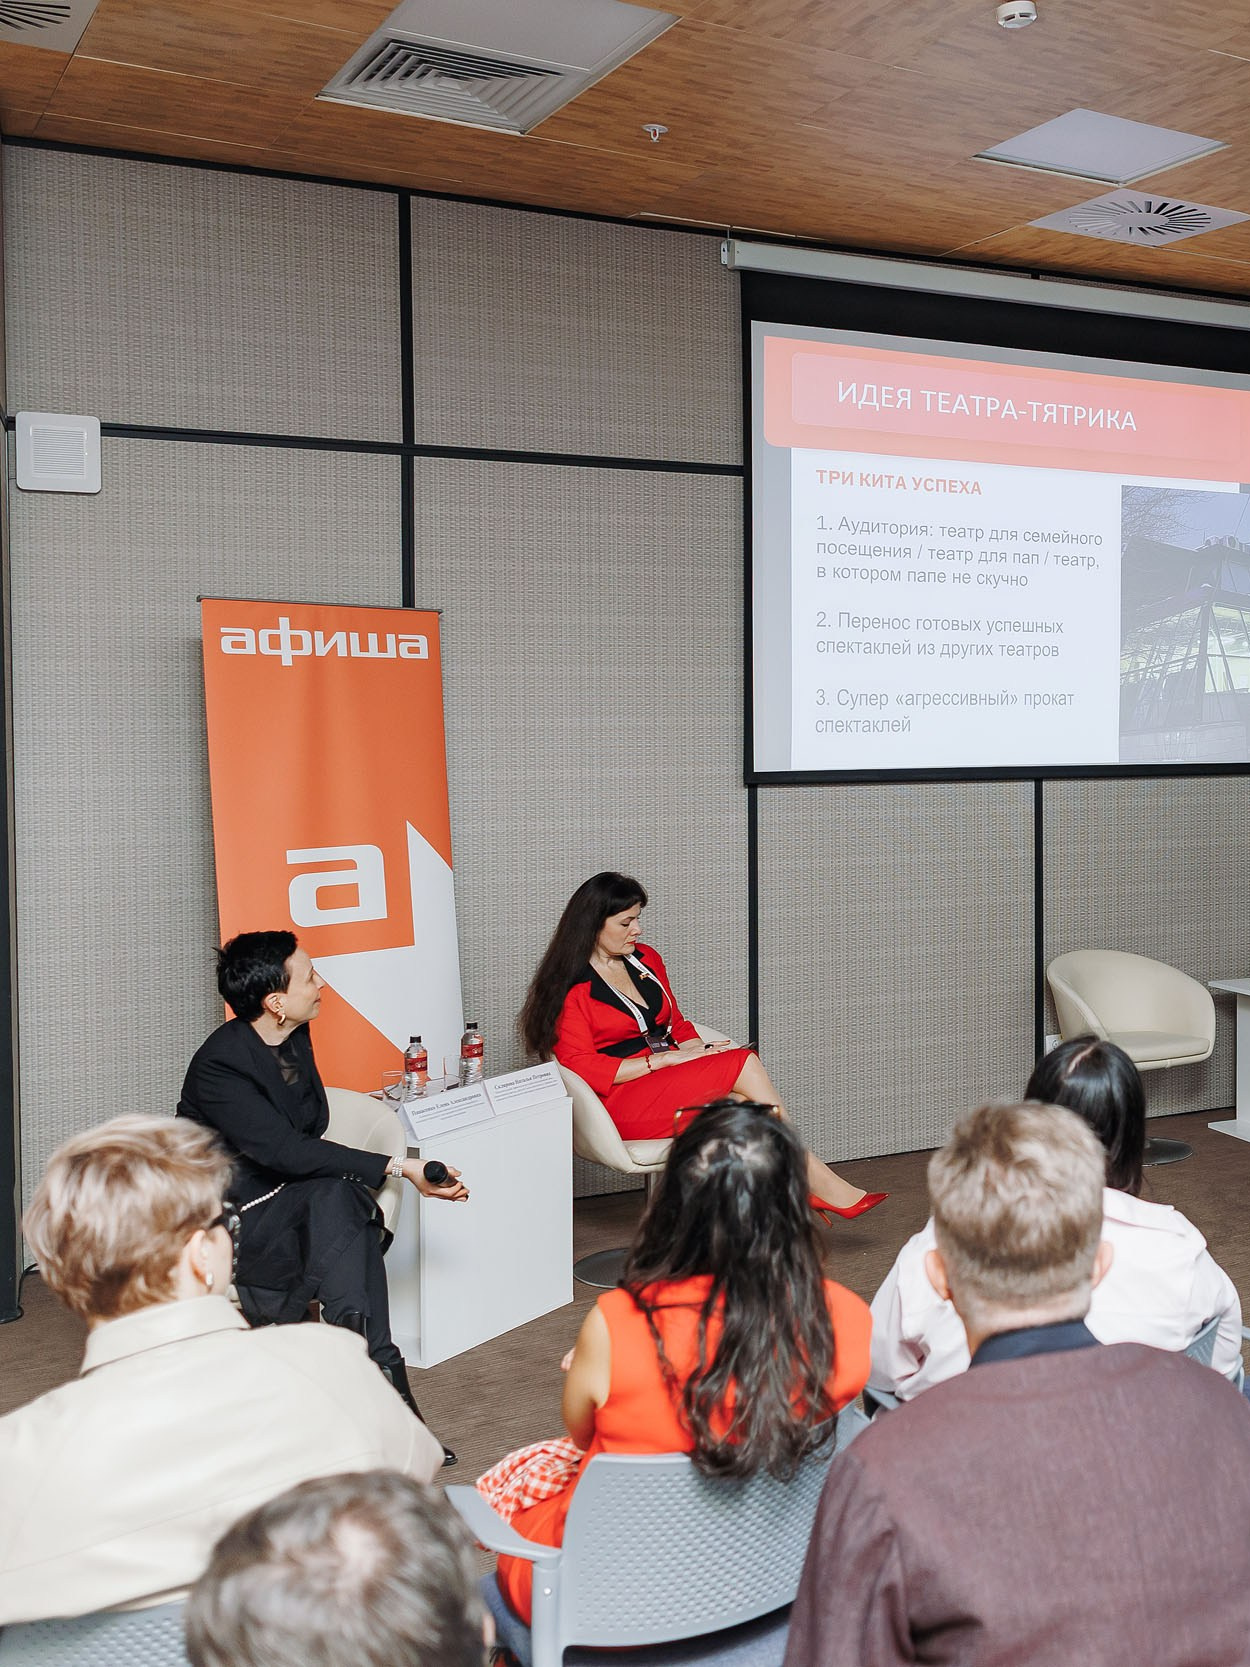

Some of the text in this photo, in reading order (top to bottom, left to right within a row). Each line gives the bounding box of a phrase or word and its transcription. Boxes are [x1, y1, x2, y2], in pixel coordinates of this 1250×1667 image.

[838, 381, 1137, 431] ИДЕЯ ТЕАТРА-ТЯТРИКА
[816, 469, 982, 495] ТРИ КИТА УСПЕХА
[816, 515, 1103, 546] 1. Аудитория: театр для семейного
[816, 541, 911, 559] посещения
[928, 547, 973, 564] театр
[978, 550, 1007, 564] для
[1013, 551, 1039, 565] пап
[1054, 553, 1100, 569] театр,
[816, 566, 1028, 589] в котором папе не скучно
[816, 611, 1064, 635] 2. Перенос готовых успешных
[220, 617, 428, 666] афиша
[816, 638, 1059, 660] спектаклей из других театров
[816, 688, 1074, 710] 3. Супер «агрессивный» прокат
[815, 715, 911, 733] спектаклей
